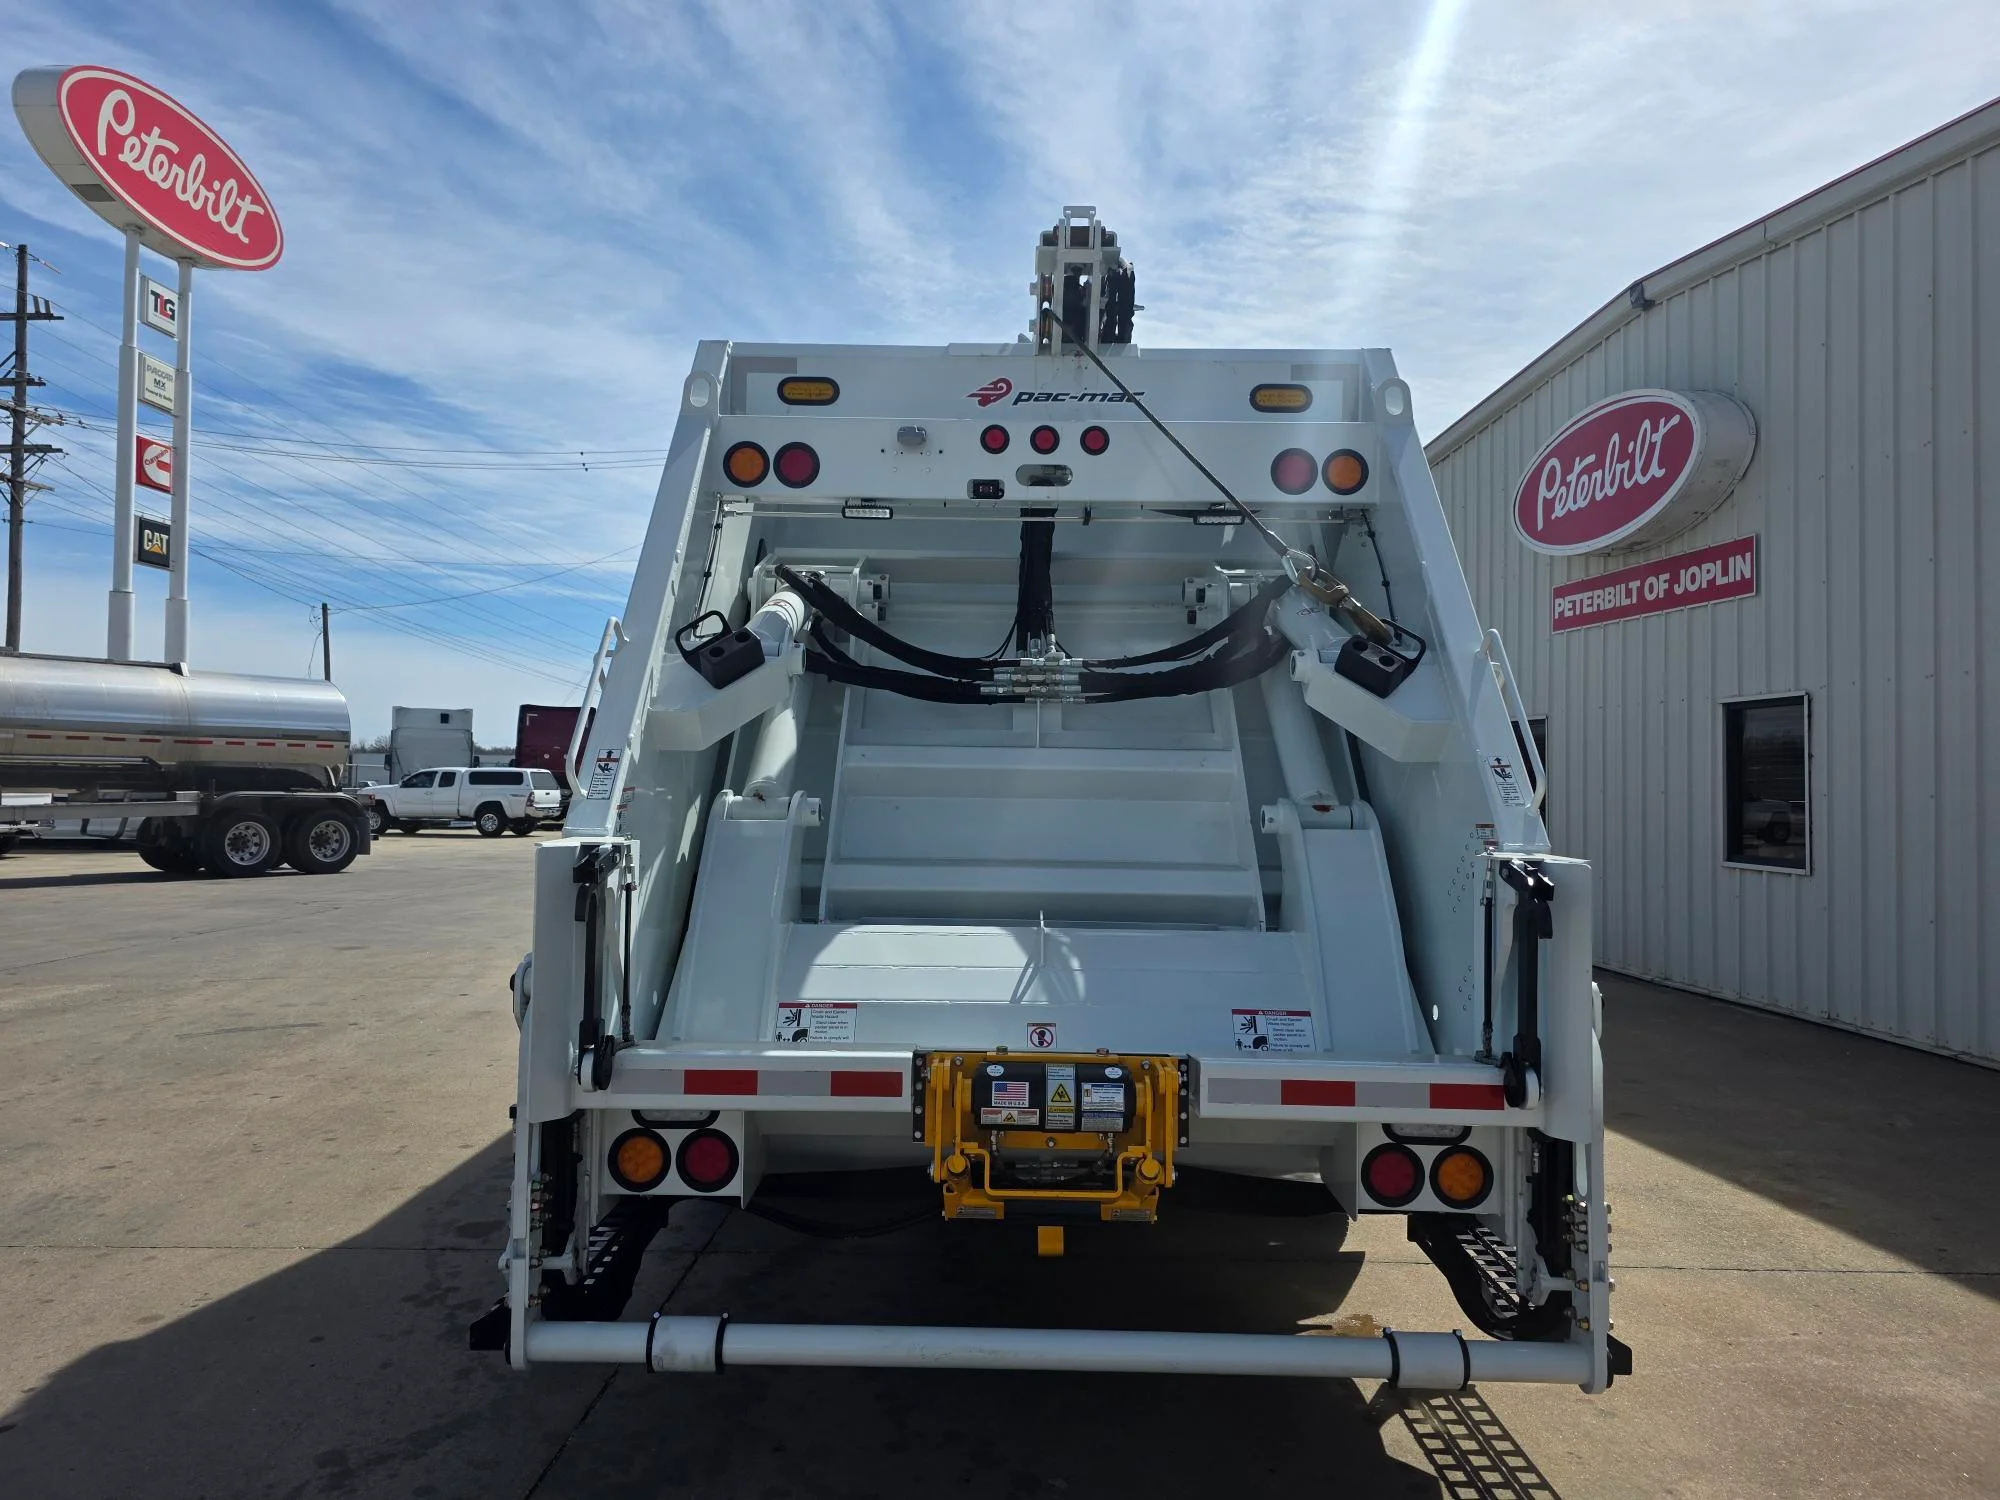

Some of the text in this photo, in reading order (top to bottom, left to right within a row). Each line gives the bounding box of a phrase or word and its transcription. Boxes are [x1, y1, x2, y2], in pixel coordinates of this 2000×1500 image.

[97, 88, 265, 244] Peterbilt
[150, 289, 176, 322] TLG
[1011, 391, 1146, 406] pac-mac
[1537, 414, 1681, 532] Peterbilt
[143, 529, 169, 556] CAT
[1554, 552, 1752, 619] PETERBILT OF JOPLIN
